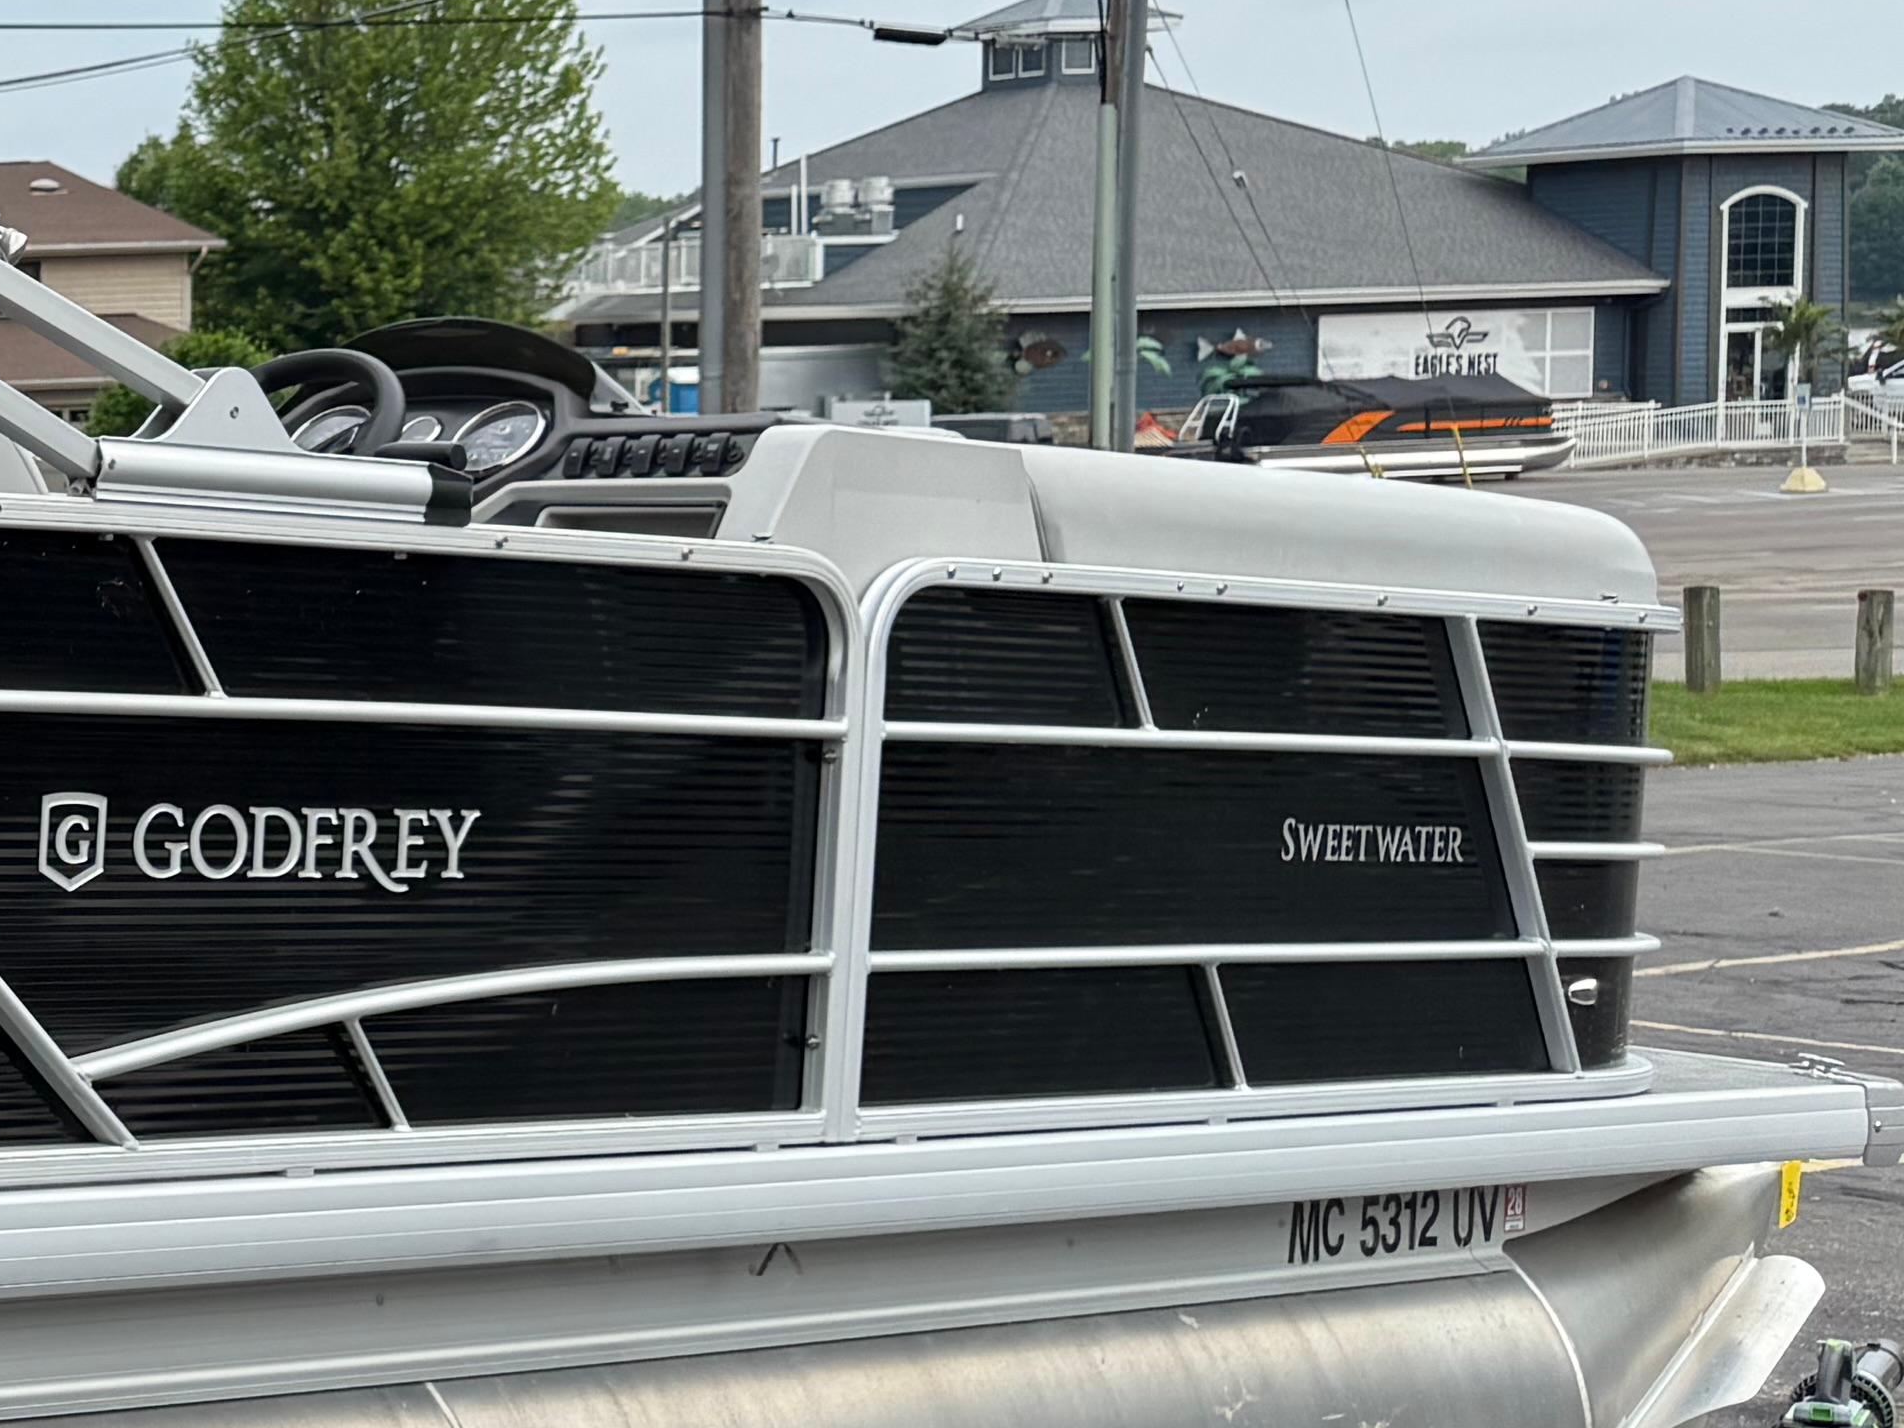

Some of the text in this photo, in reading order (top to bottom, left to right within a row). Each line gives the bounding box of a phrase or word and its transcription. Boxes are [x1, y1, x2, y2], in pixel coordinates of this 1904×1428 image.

[1468, 352, 1498, 376] NEST
[133, 802, 482, 893] GODFREY
[1288, 1184, 1500, 1264] MC 5312 UV
